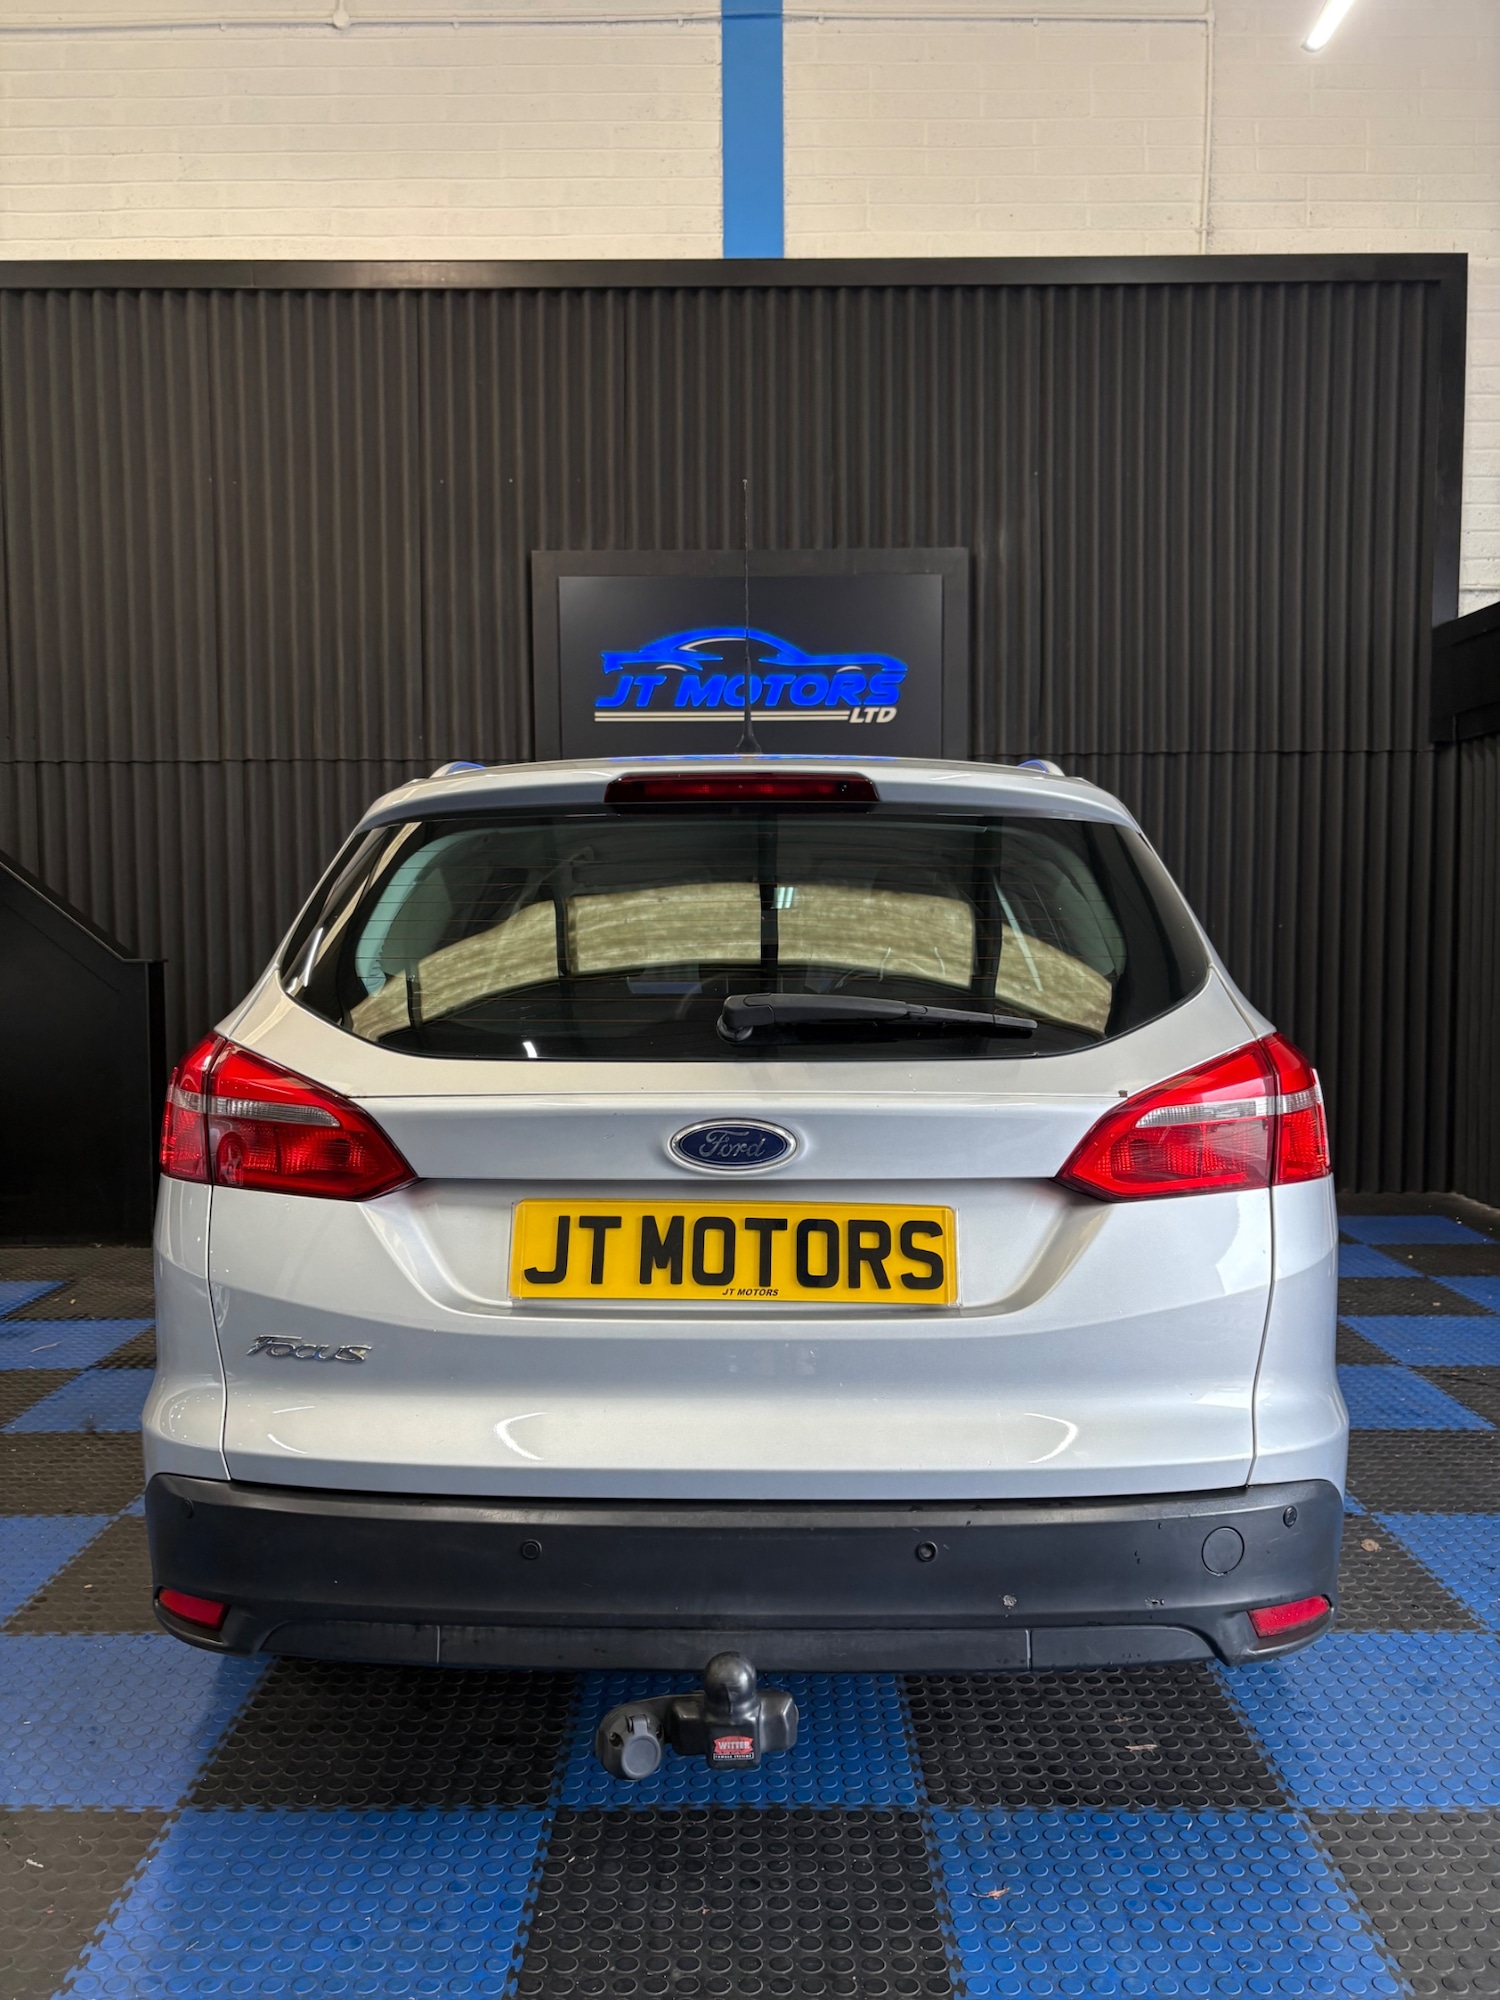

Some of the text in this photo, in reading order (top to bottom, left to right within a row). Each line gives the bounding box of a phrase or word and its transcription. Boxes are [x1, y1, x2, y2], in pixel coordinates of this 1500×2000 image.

[595, 674, 907, 707] JT MOTORS
[850, 707, 897, 724] LTD
[698, 1129, 766, 1158] Ford
[524, 1215, 944, 1290] JT MOTORS
[722, 1288, 779, 1297] JT MOTORS
